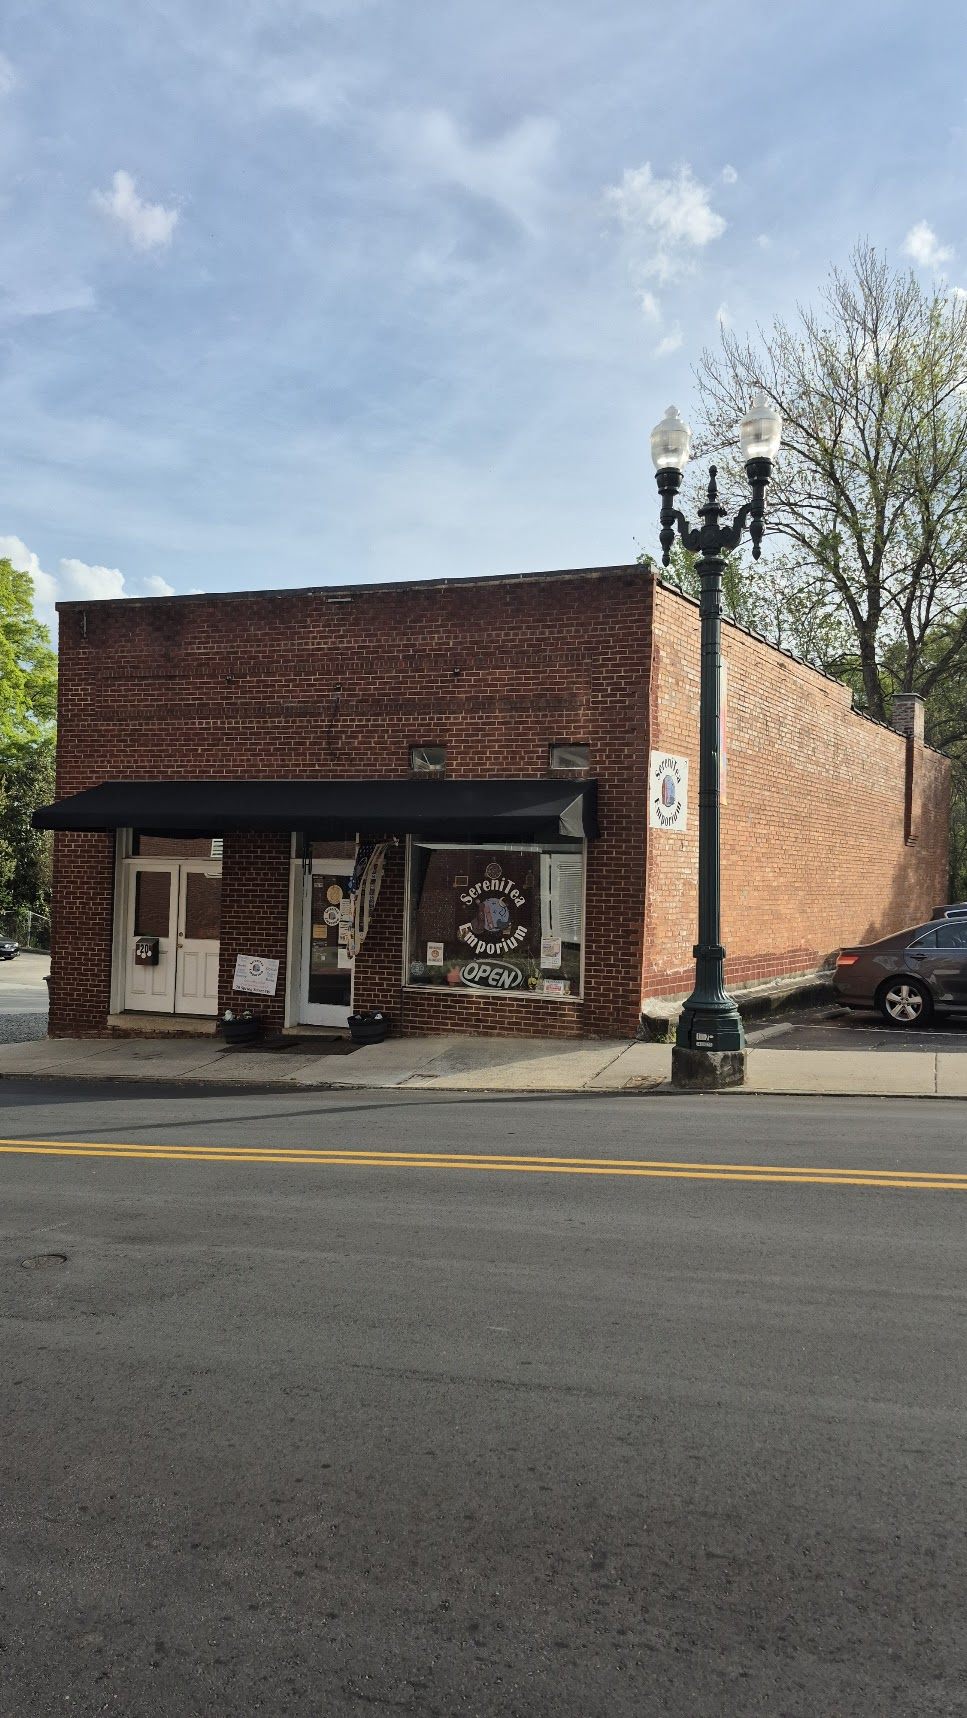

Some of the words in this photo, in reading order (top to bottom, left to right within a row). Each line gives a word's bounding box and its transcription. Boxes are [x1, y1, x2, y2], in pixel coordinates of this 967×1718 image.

[655, 757, 681, 784] SereniTea
[654, 797, 682, 827] Emporium
[460, 877, 526, 908] SereniTea
[139, 941, 149, 954] 20
[459, 922, 528, 955] Emporium
[463, 962, 516, 989] OPEN
